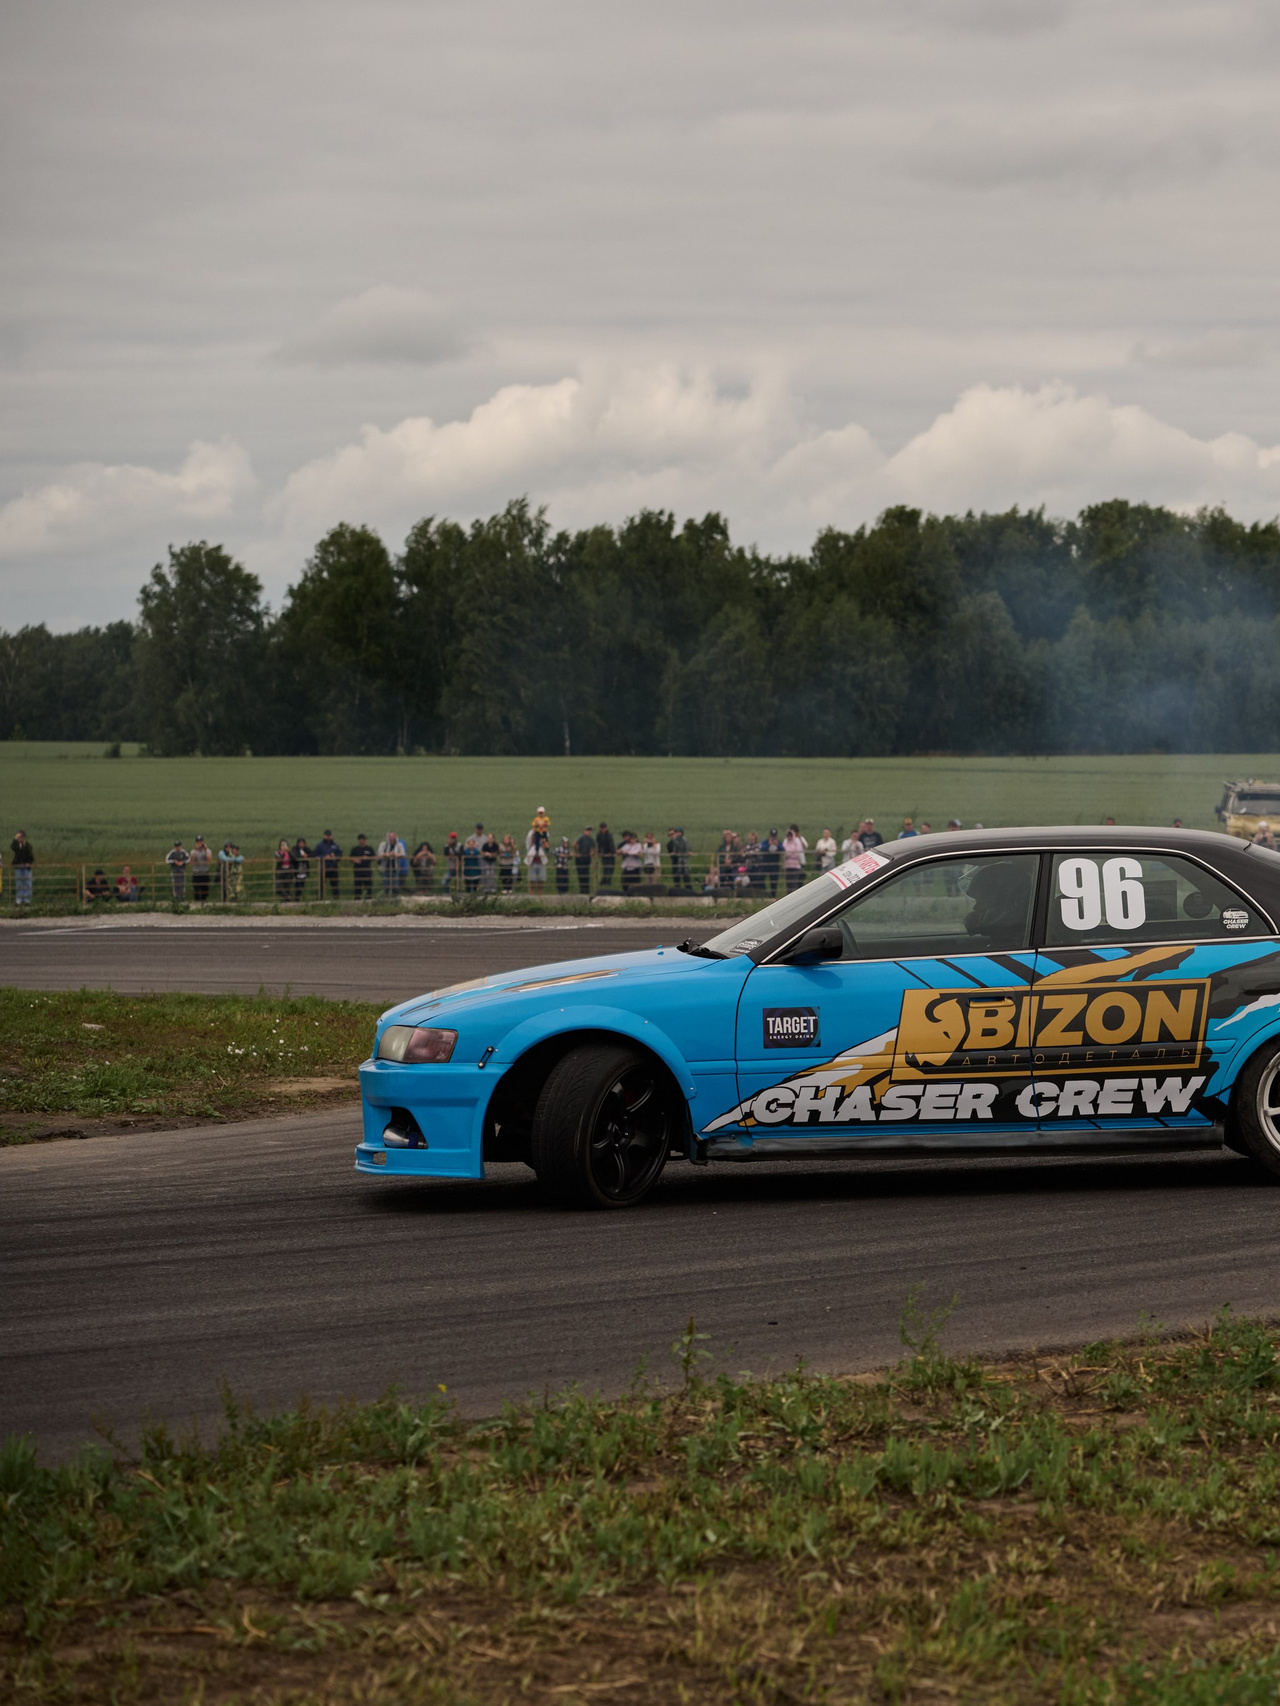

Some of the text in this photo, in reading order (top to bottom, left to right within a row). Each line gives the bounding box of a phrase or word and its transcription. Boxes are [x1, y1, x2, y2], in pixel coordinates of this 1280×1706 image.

[1058, 857, 1147, 931] 96
[766, 1016, 816, 1034] TARGET
[962, 988, 1198, 1050] BIZON
[960, 1047, 1192, 1067] АВТОДЕТАЛЬ
[750, 1076, 1207, 1123] CHASER CREW
